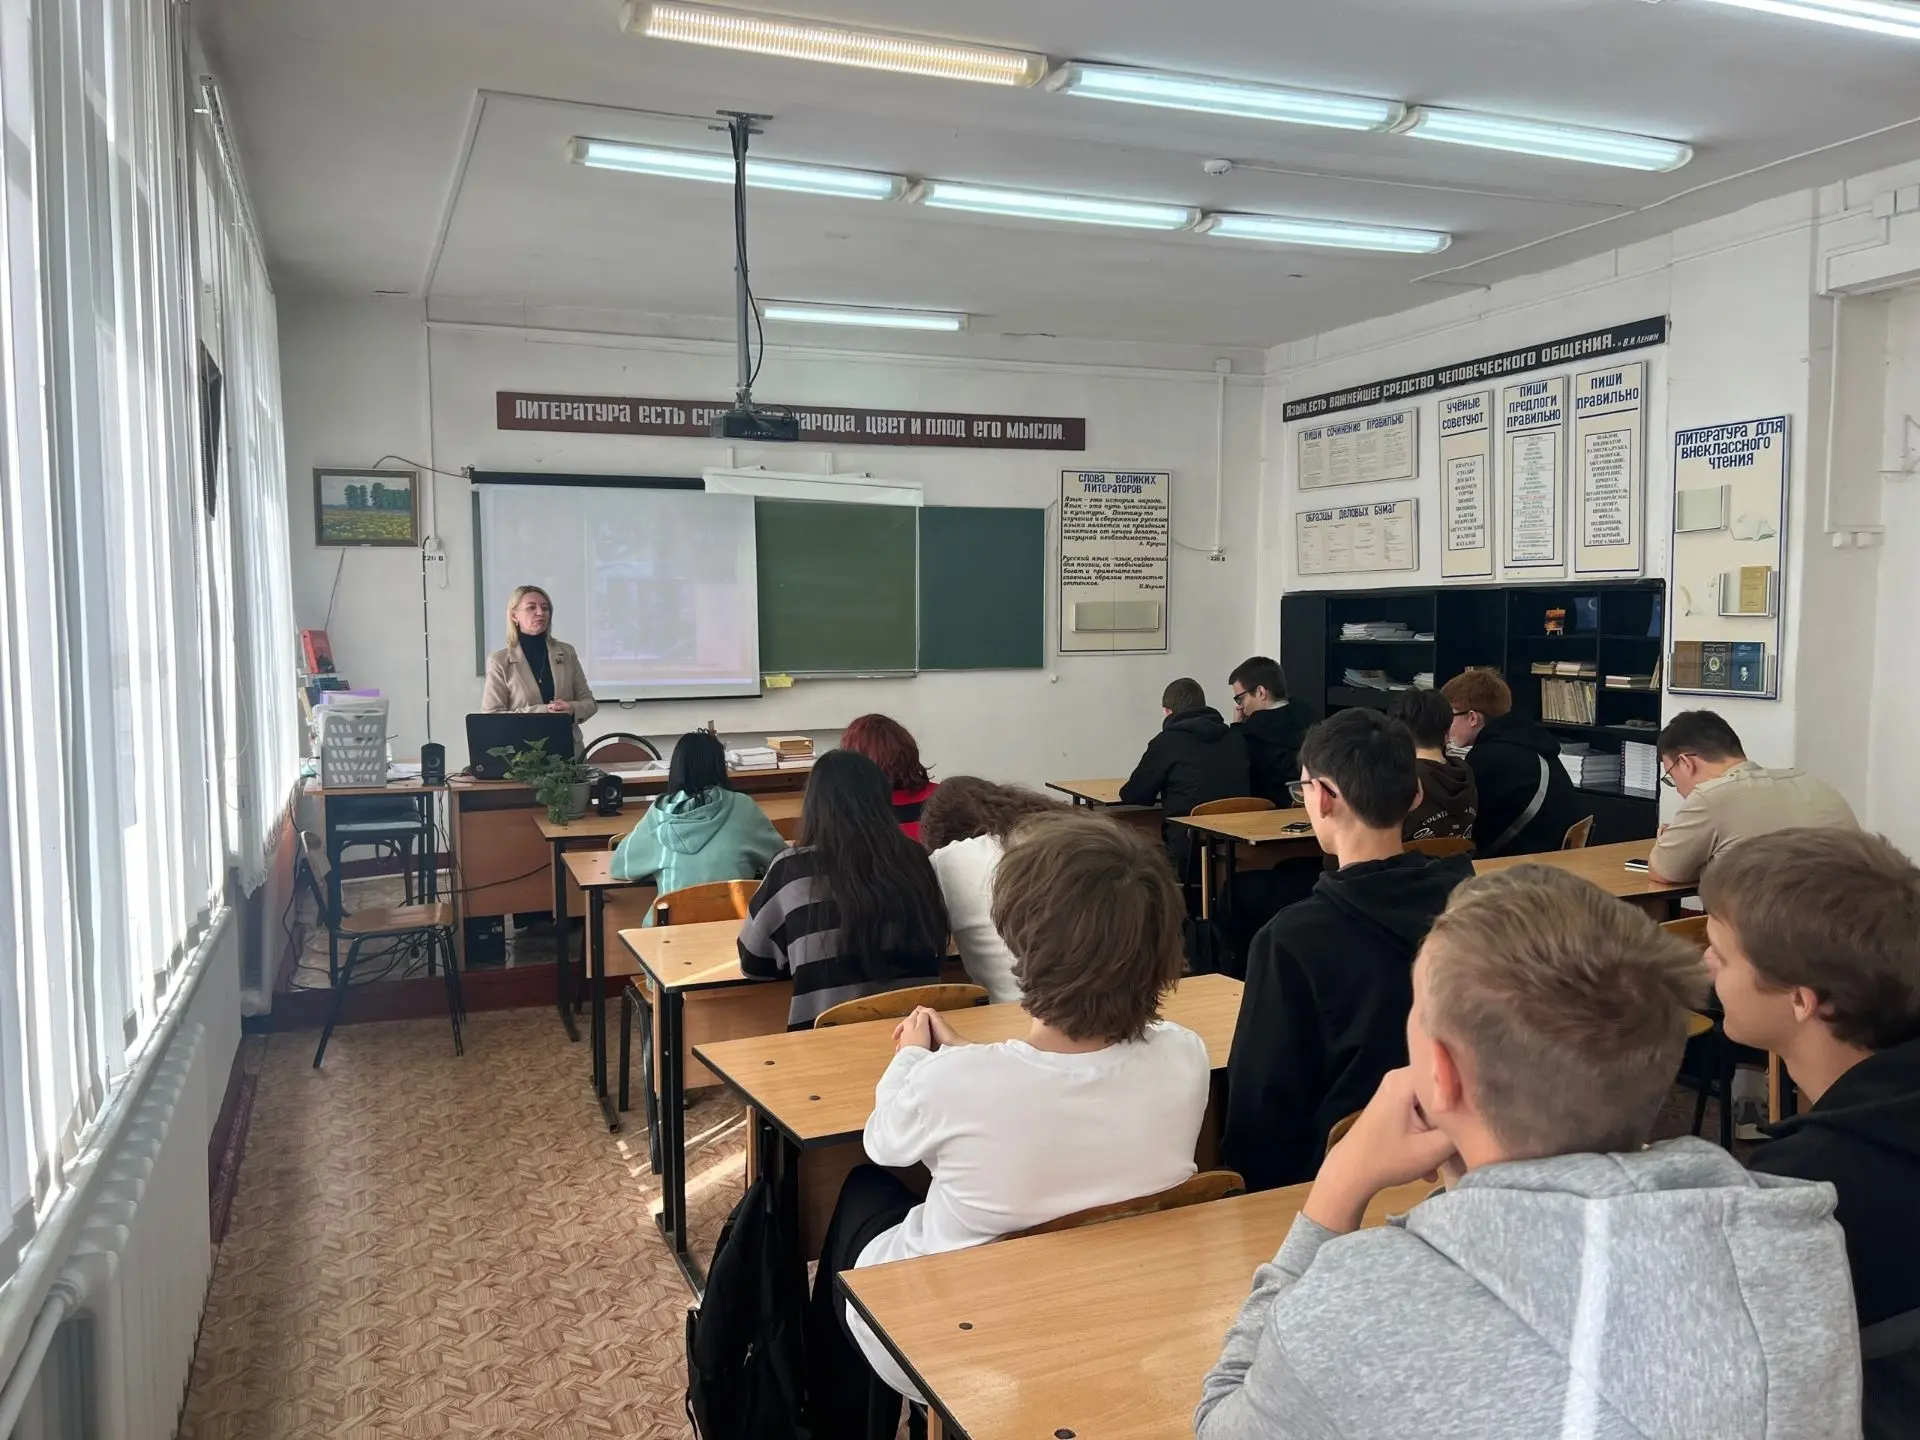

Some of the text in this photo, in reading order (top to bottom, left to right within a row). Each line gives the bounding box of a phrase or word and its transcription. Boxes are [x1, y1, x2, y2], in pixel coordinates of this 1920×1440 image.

[1308, 398, 1327, 413] ЕСТЬ
[1329, 386, 1381, 408] ВАЖНЕЙШЕЕ
[1383, 375, 1434, 397] СРЕДСТВО
[1438, 352, 1536, 384] ЧЕЛОВЕЧЕСКОГО
[1520, 382, 1548, 398] ПИШИ
[1591, 372, 1622, 390] ПИШИ
[1447, 397, 1480, 414] УЧЁНЫЕ
[1509, 395, 1558, 414] ПРЕДЛОГИ
[1576, 388, 1639, 410] ПРАВИЛЬНО
[515, 400, 631, 422] ЛИТЕРАТУРА
[638, 405, 686, 424] ЕСТЬ
[866, 416, 906, 434] ЦВЕТ
[910, 418, 921, 435] И
[926, 418, 966, 438] ПЛОД
[973, 421, 1001, 438] ЕГО
[1006, 422, 1066, 440] МЫСЛИ.
[1304, 414, 1404, 441] ПИШИ СОЧИНЕНИЕ ПРАВИЛЬНО
[1442, 412, 1484, 430] СОВЕТУЮТ
[1507, 409, 1561, 428] ПРАВИЛЬНО
[1677, 420, 1783, 446] ЛИТЕРАТУРА ДЛЯ
[1681, 436, 1770, 459] ВНЕКЛАССНОГО
[1708, 452, 1754, 470] ЧТЕНИЯ
[1078, 474, 1156, 484] СЛОВА ВЕЛИКИХ
[1084, 484, 1142, 494] ЛИТЕРАТОРОВ
[1306, 504, 1396, 522] ОБРАЗЦЫ ДЕЛОВЫХ БУМАГ
